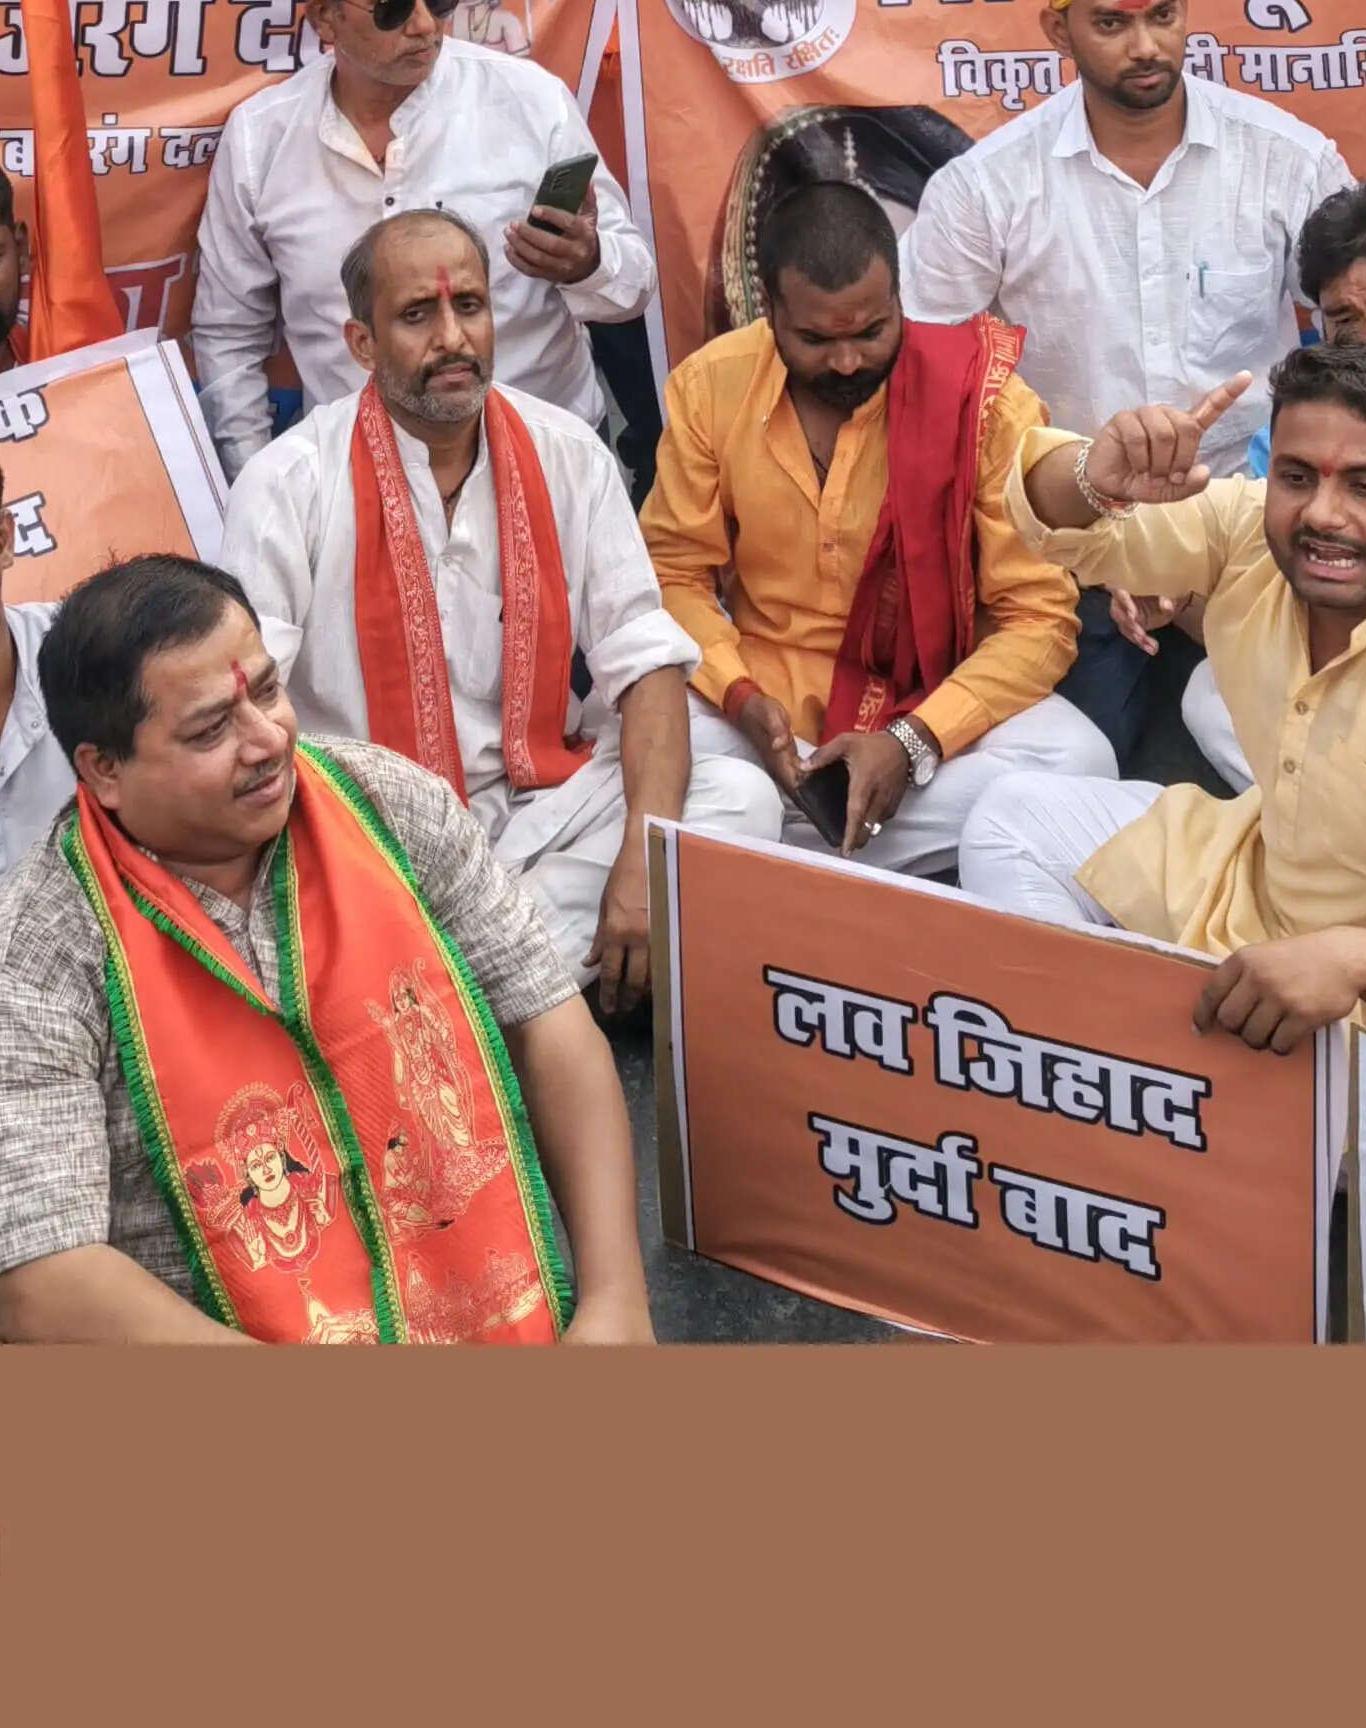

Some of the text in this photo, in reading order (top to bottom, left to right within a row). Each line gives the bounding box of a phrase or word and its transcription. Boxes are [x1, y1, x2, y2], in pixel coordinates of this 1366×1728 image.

[936, 39, 1066, 111] विकृत
[762, 965, 1211, 1153] लव जिहाद
[808, 1112, 1166, 1282] मुर्दा बाद
